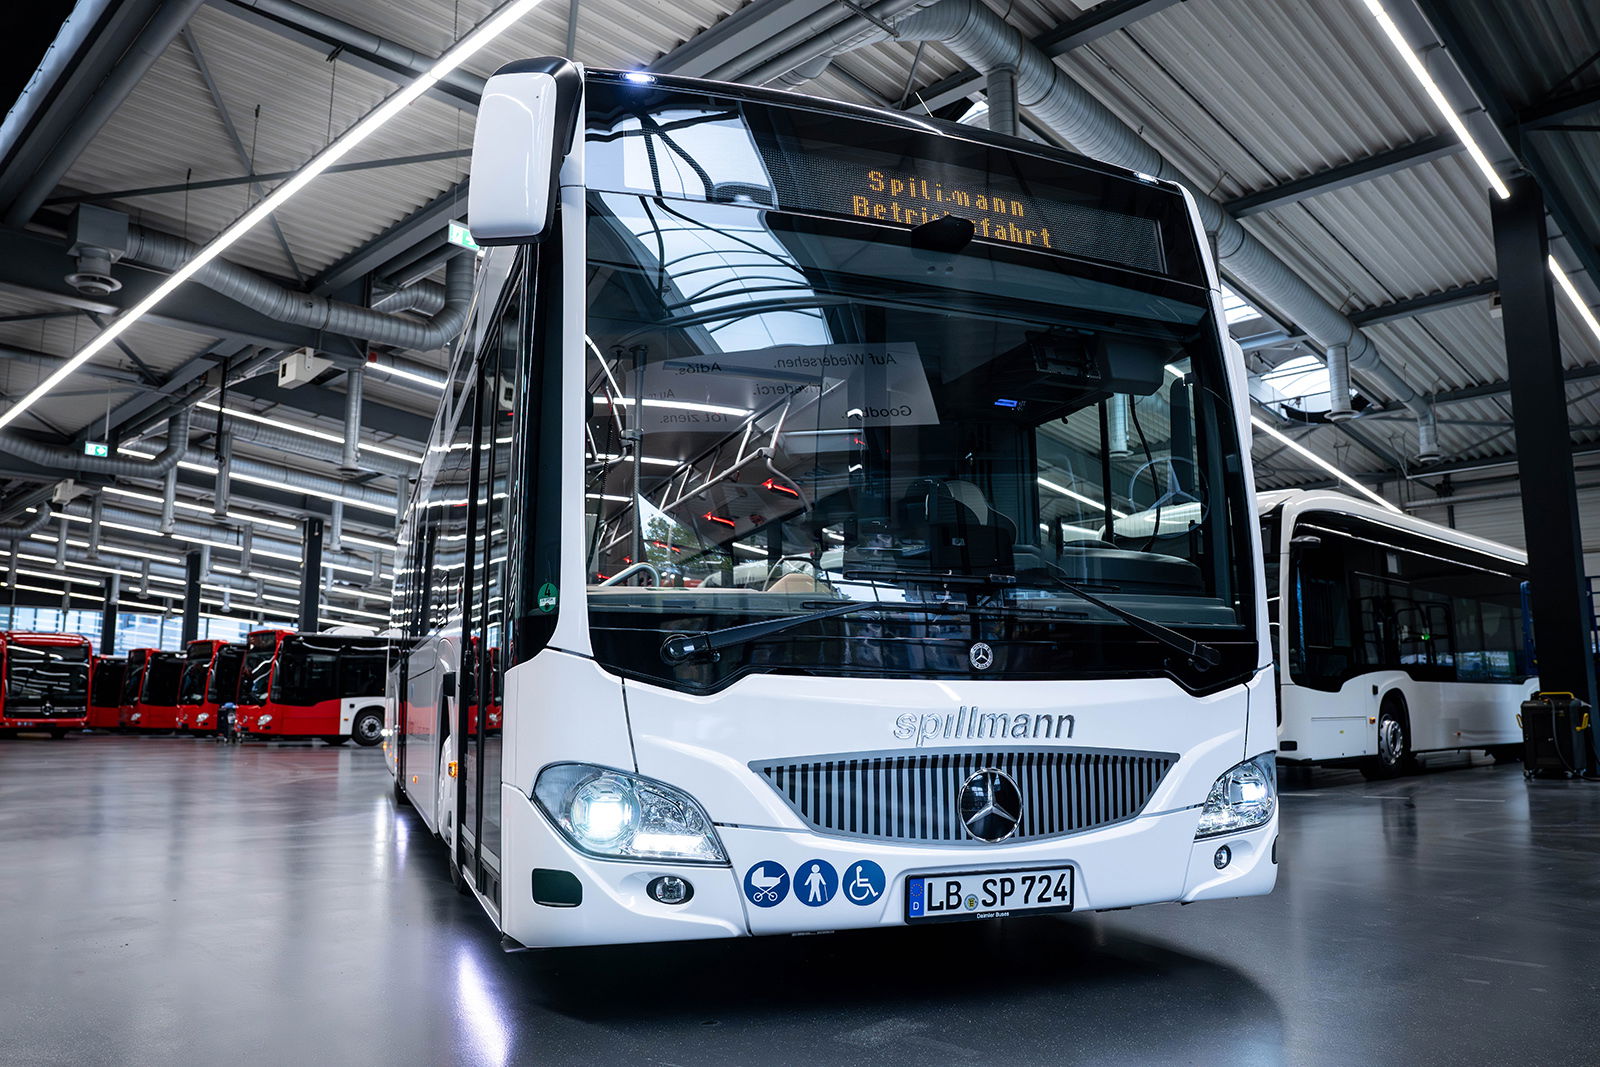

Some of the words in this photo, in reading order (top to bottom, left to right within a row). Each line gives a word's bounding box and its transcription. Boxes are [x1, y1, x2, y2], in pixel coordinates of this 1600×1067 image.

[852, 195, 1052, 248] Betrifahrt
[544, 583, 551, 597] 4
[893, 705, 1076, 748] spillmann
[912, 901, 920, 911] D
[927, 881, 962, 911] LB
[981, 877, 1016, 907] SP
[1021, 873, 1068, 905] 724
